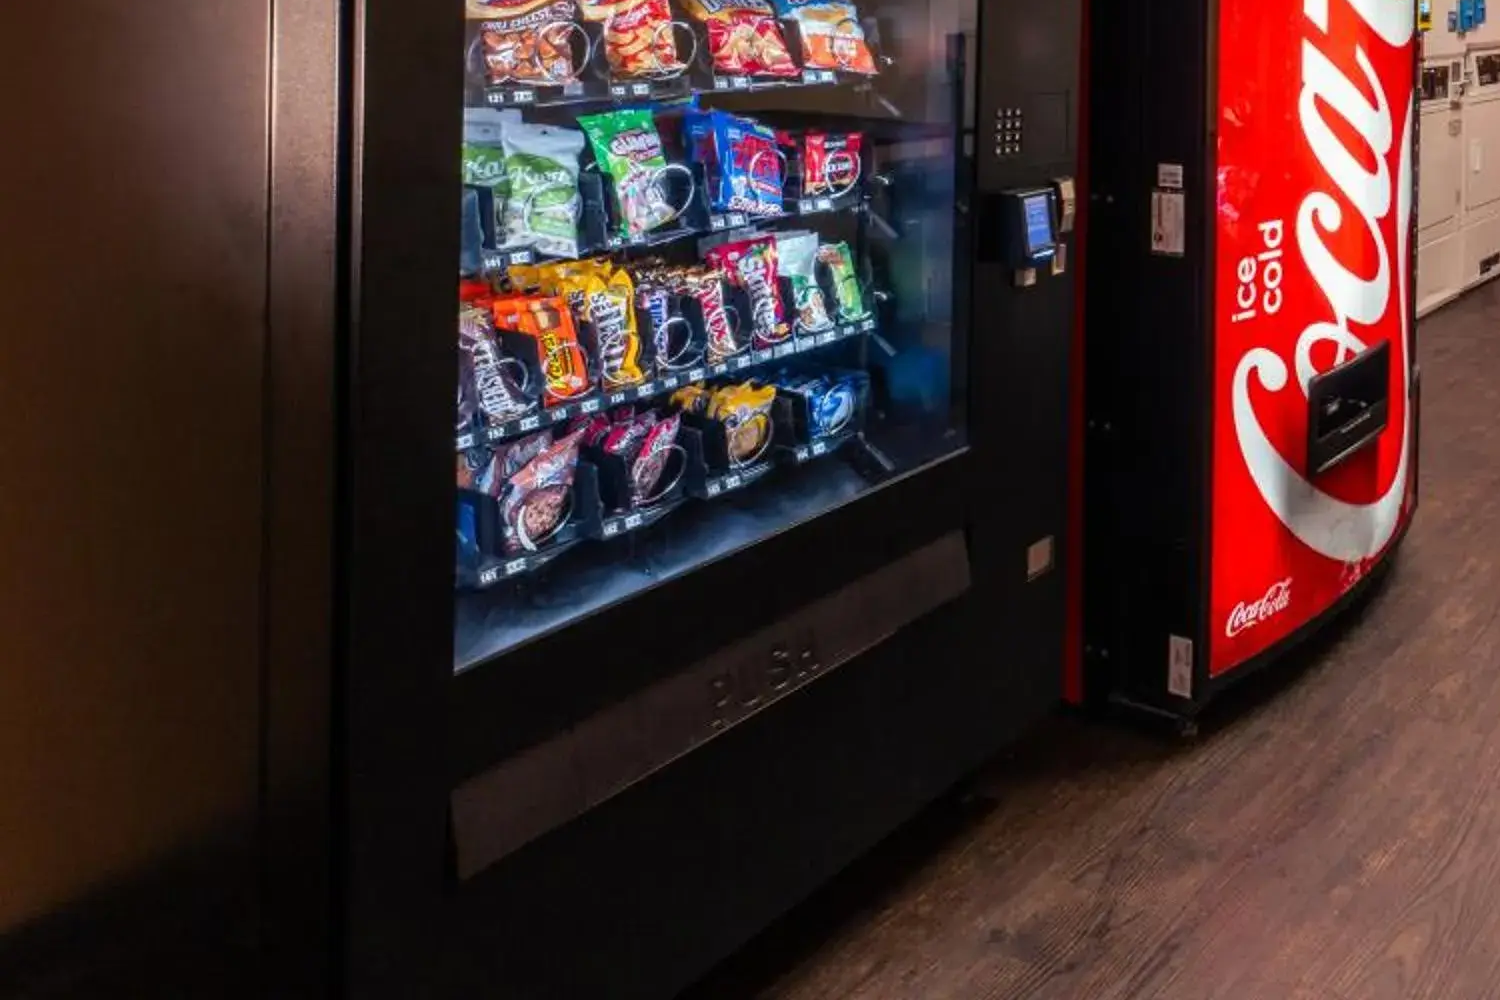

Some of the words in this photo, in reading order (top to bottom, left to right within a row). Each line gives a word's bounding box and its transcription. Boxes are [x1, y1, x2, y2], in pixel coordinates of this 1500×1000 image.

[1232, 256, 1257, 321] ice
[1257, 219, 1283, 314] cold
[1226, 577, 1292, 637] Coca-Cola
